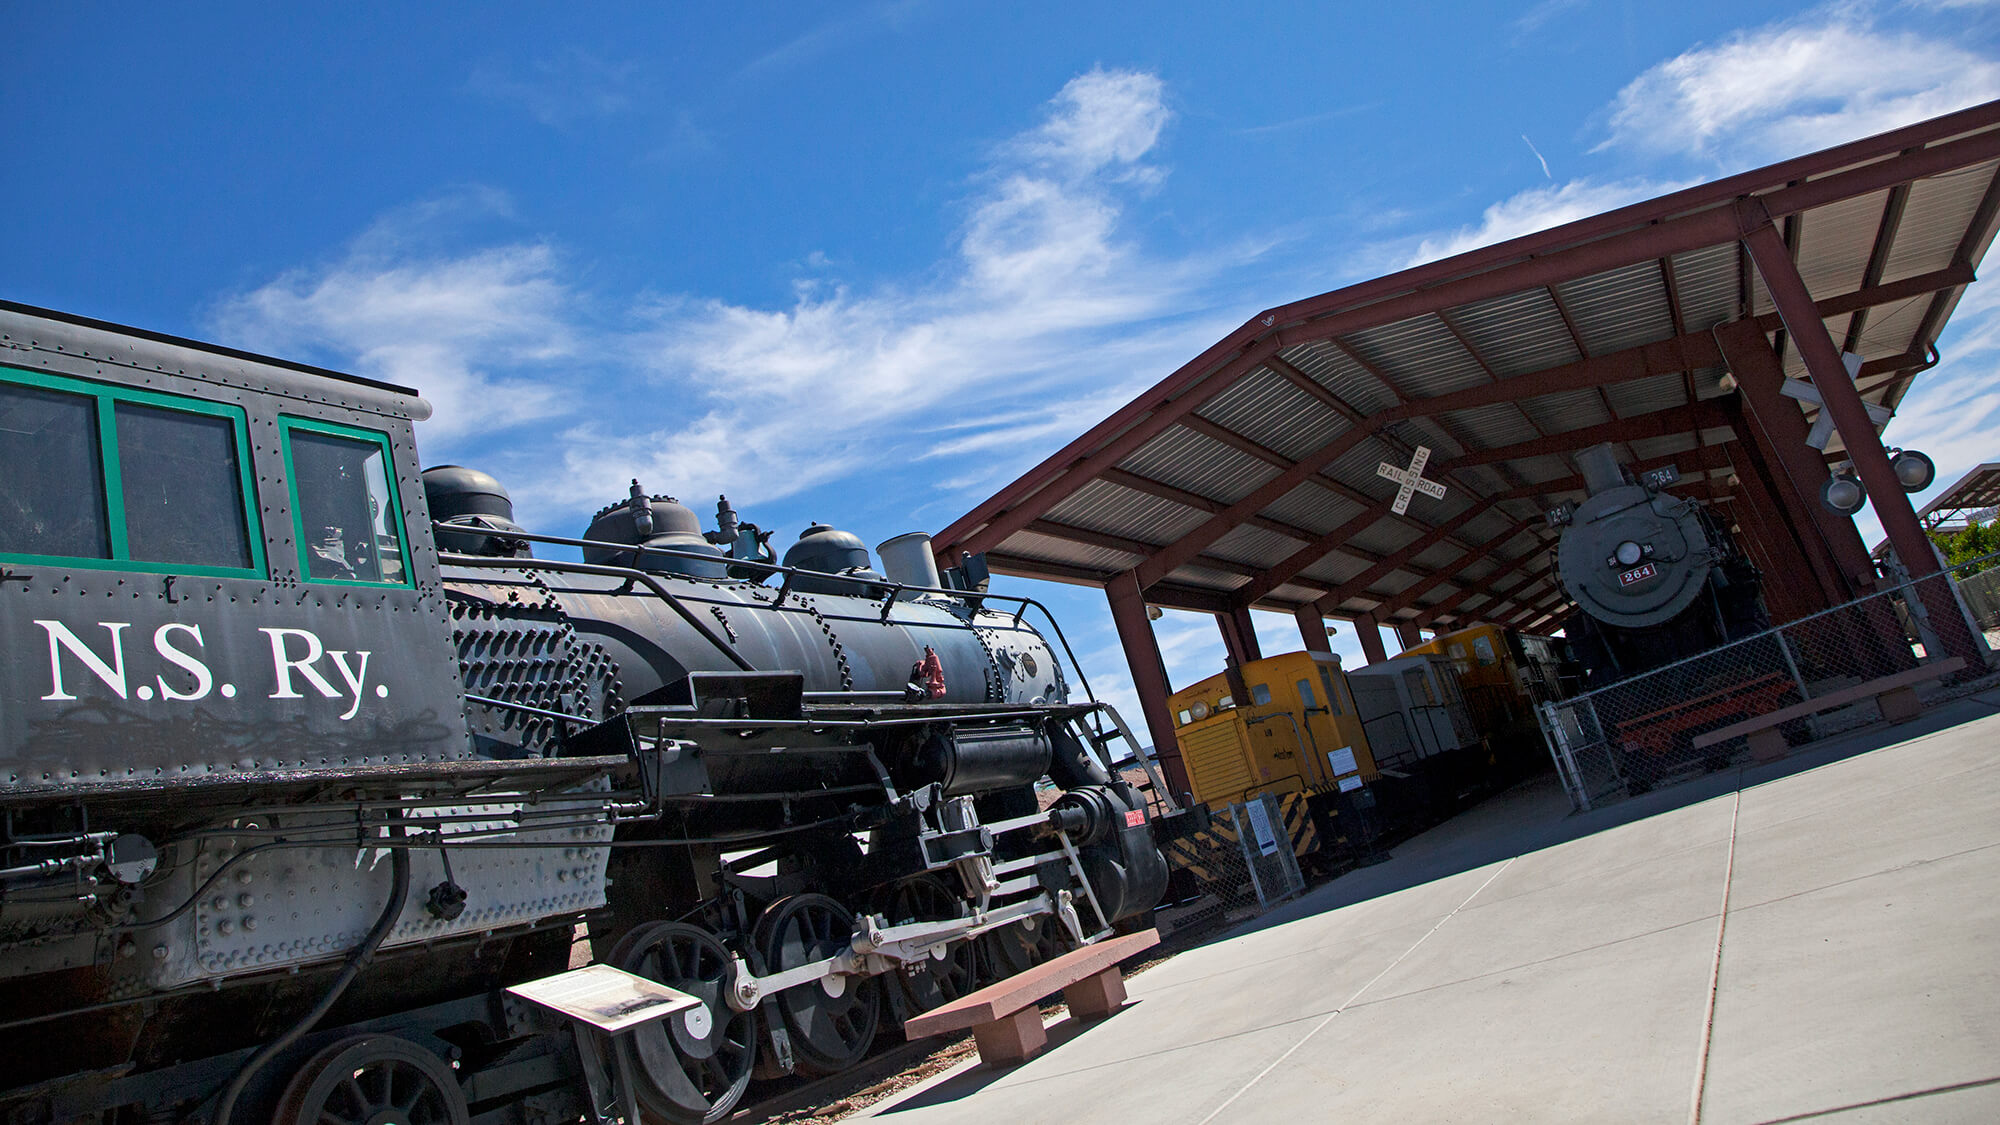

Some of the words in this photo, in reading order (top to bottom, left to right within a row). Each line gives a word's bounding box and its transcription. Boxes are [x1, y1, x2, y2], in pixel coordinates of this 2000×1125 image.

[1379, 464, 1403, 481] RAIL
[1417, 480, 1445, 497] ROAD
[1395, 450, 1427, 510] CROSSING
[1624, 567, 1651, 582] 264
[33, 619, 238, 701] N.S.
[258, 627, 390, 721] Ry.
